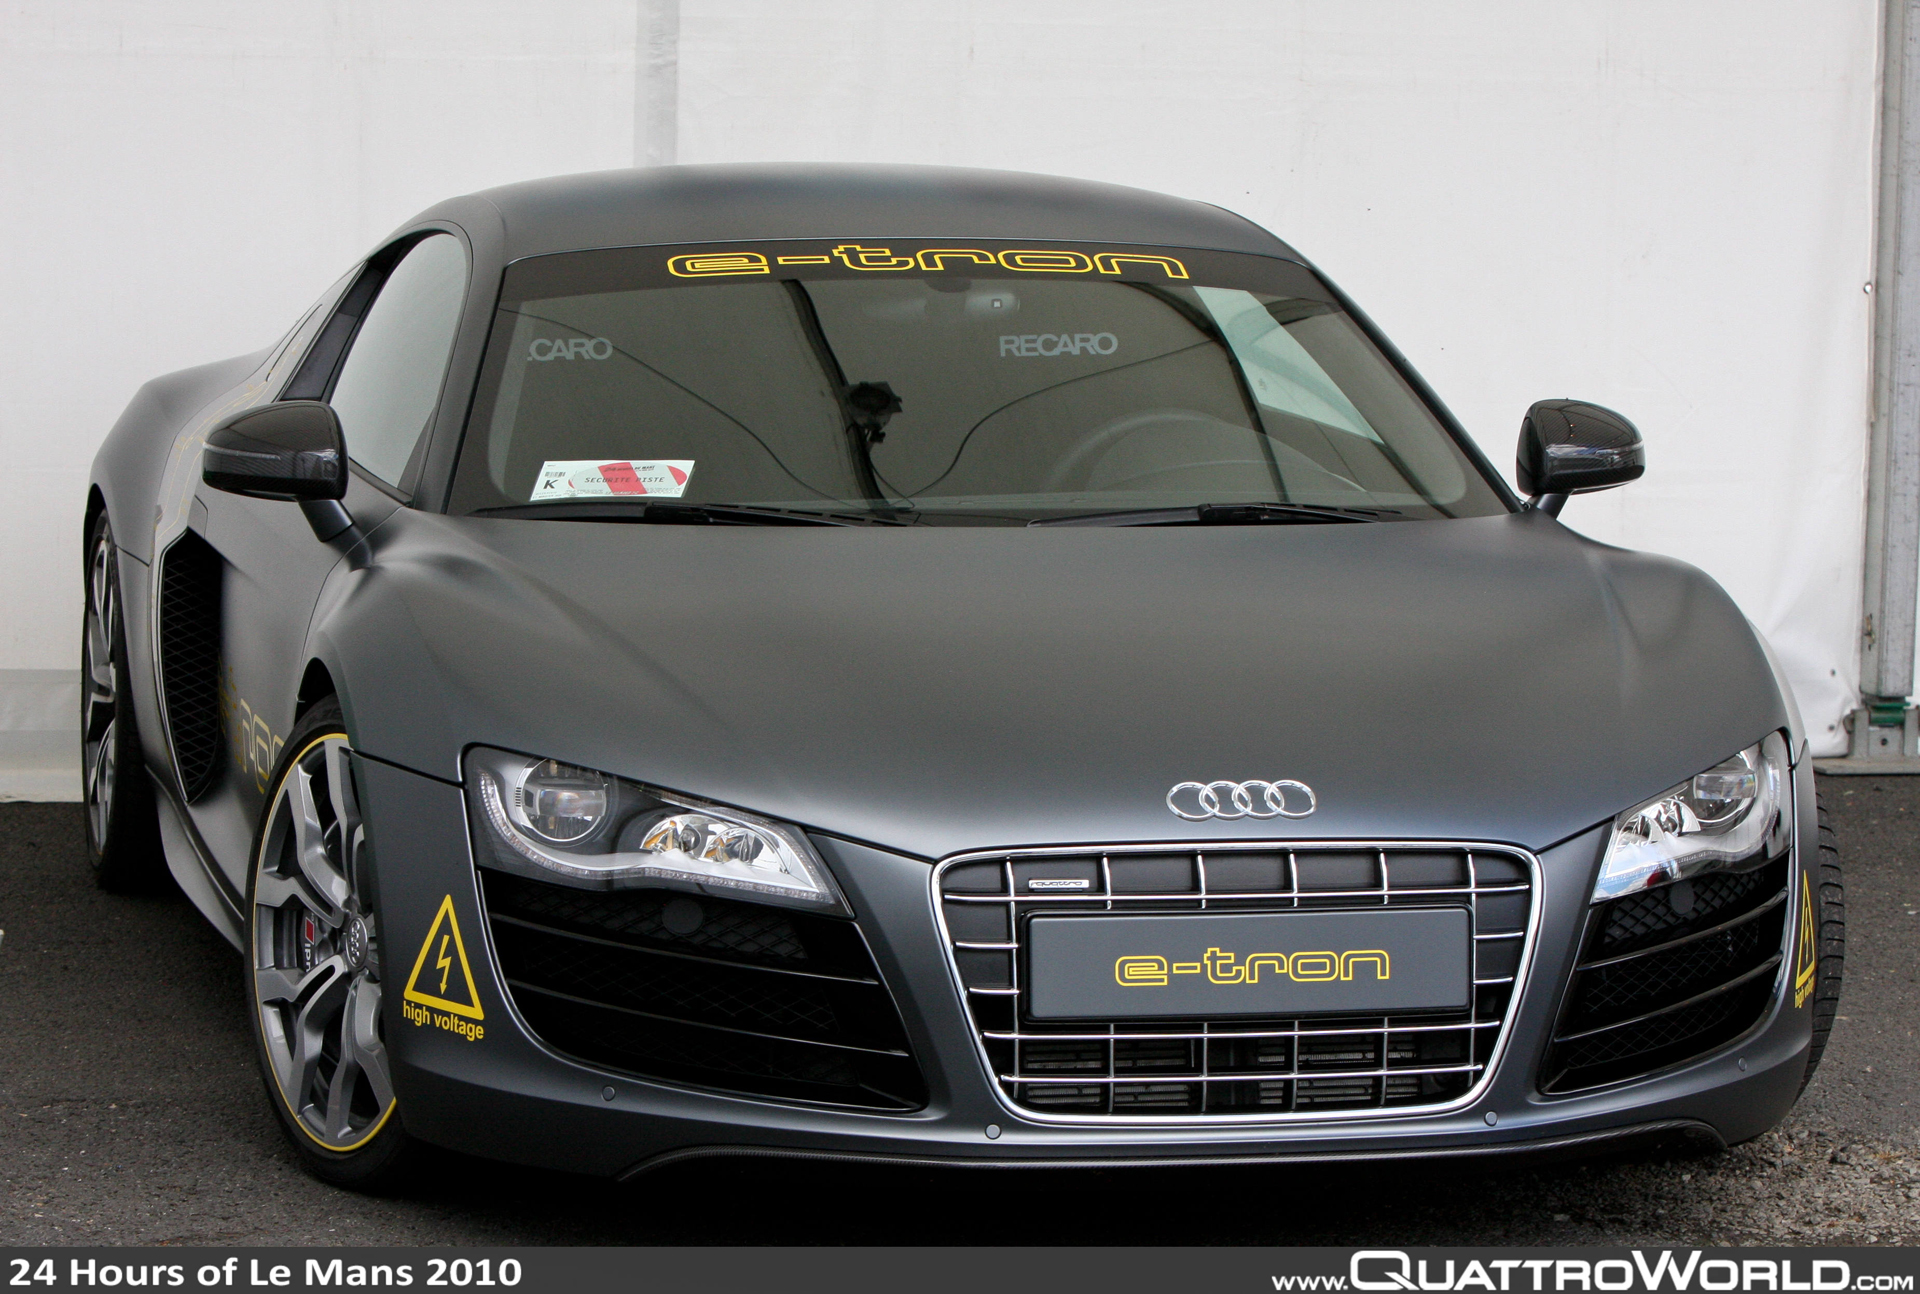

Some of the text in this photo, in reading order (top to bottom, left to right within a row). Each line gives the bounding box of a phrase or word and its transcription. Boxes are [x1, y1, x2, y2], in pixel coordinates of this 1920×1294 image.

[667, 244, 1190, 280] e-tron
[527, 337, 614, 361] CARO
[999, 332, 1118, 357] RECARO
[543, 479, 559, 490] K
[584, 476, 665, 484] SECURITE PISTE
[1114, 946, 1391, 987] e-tron
[403, 1000, 484, 1042] high voltage
